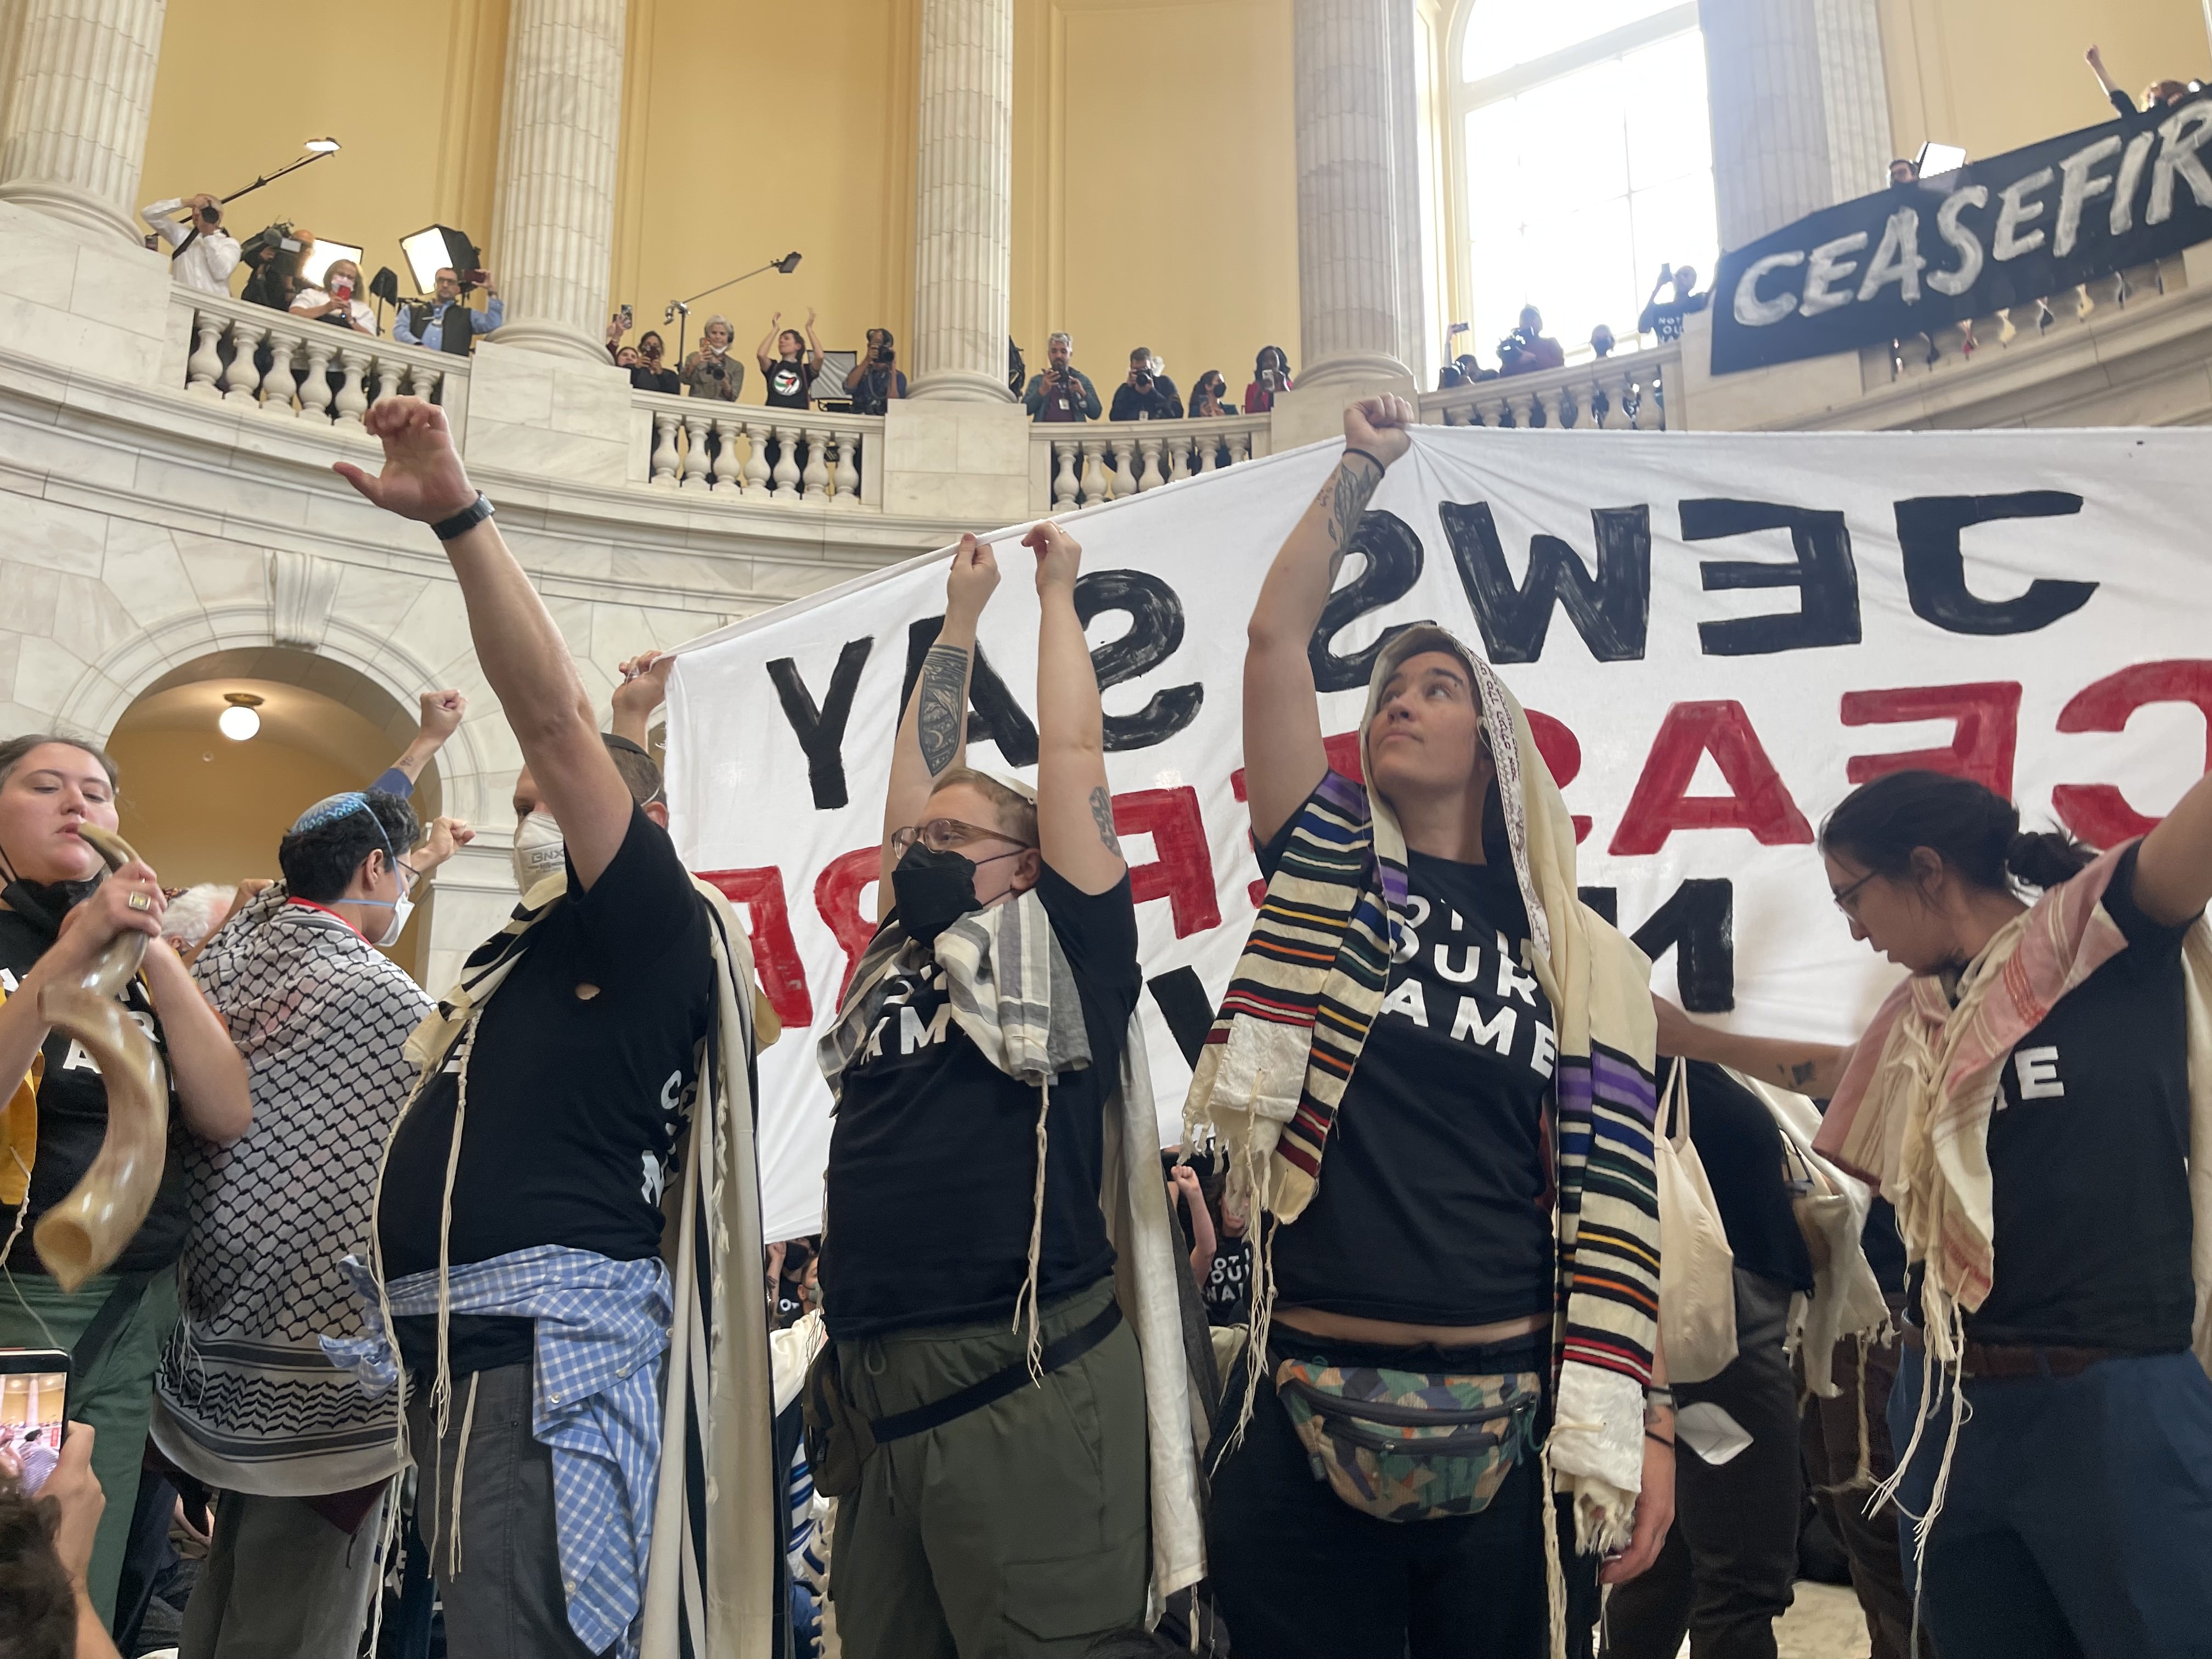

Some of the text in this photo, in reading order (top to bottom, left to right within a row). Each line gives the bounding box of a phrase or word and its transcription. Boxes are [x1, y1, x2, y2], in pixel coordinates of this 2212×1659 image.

[1663, 325, 1682, 334] OU
[1379, 978, 1555, 1080] AME
[1214, 1255, 1239, 1270] OT
